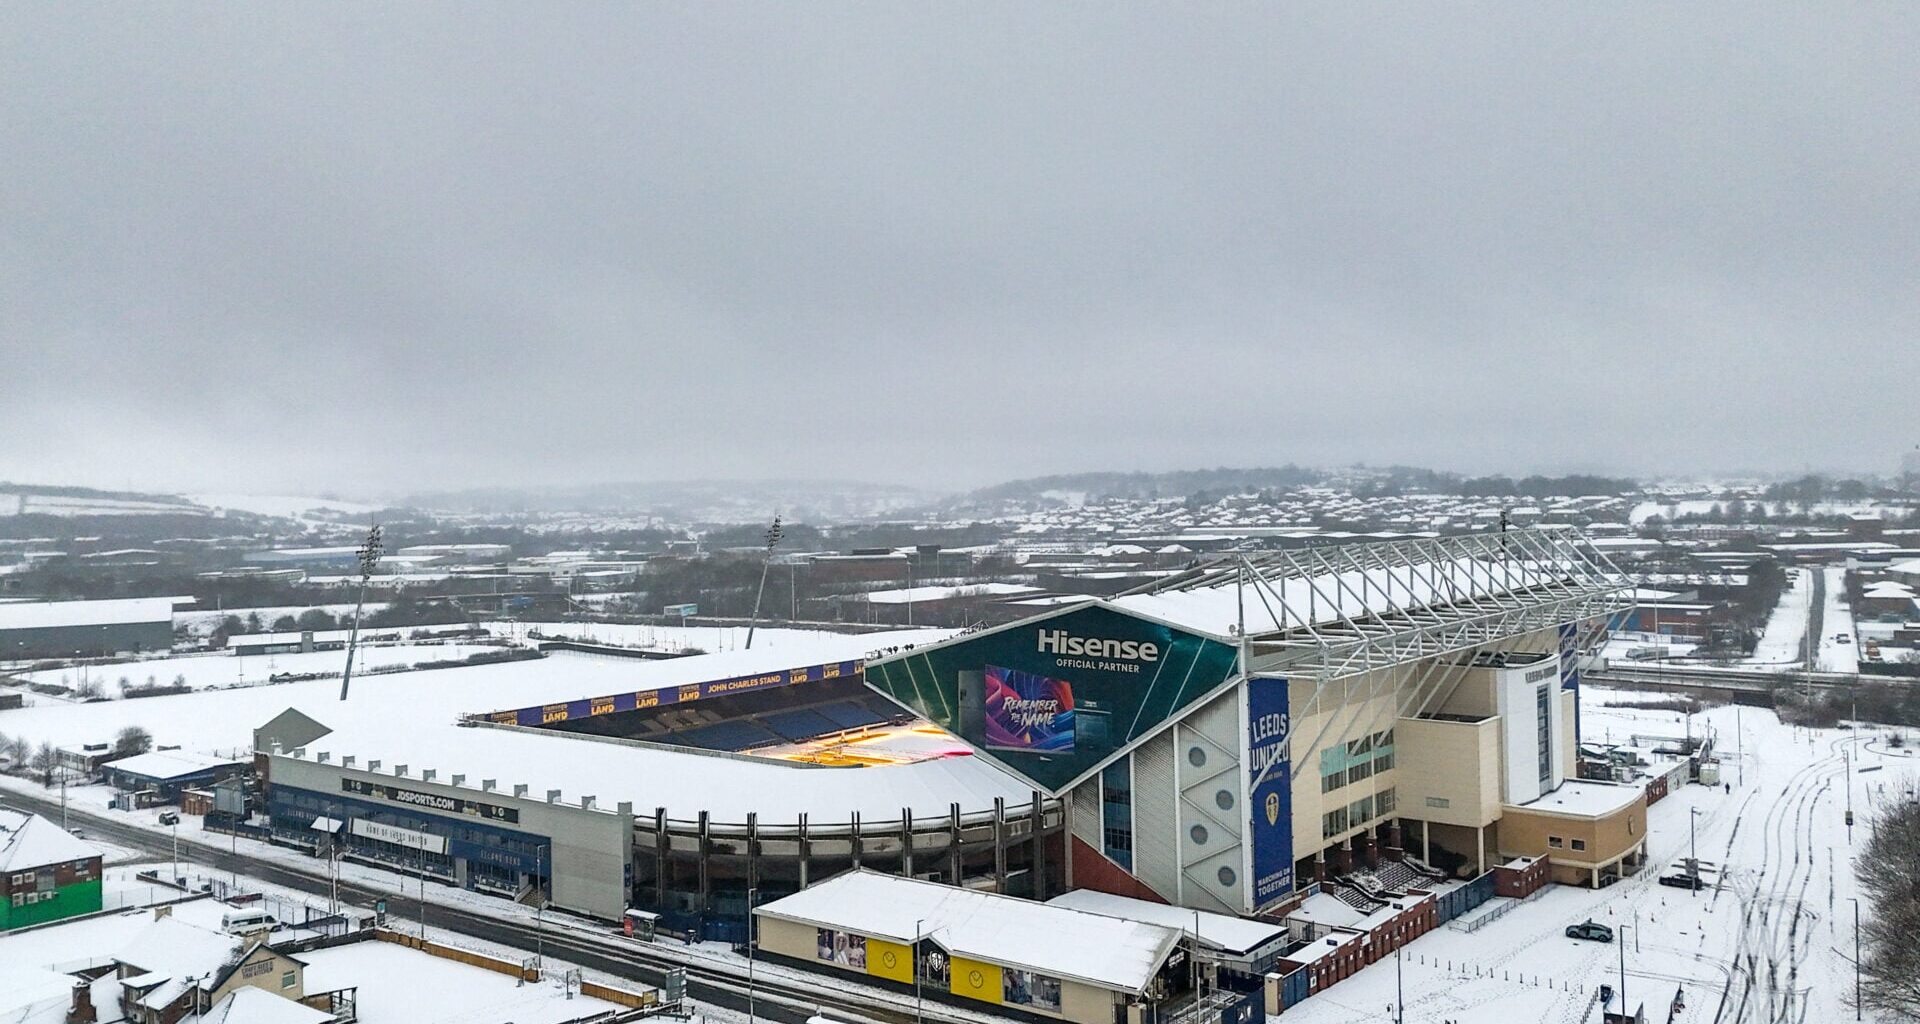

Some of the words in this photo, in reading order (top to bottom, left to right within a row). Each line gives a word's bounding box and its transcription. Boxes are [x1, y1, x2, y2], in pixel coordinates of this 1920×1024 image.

[1038, 628, 1158, 662] Hisense
[1056, 658, 1096, 670] OFFICIAL
[1098, 661, 1140, 674] PARTNER
[708, 684, 727, 693] JOHN
[728, 679, 758, 689] CHARLES
[760, 675, 781, 685] STAND
[636, 697, 659, 709] LAND
[679, 691, 700, 702] LAND
[1002, 696, 1058, 713] REMEMBER
[543, 710, 568, 724] LAND
[590, 703, 615, 716] LAND
[1020, 712, 1055, 727] NAME
[1253, 713, 1288, 743] LEEDS
[396, 790, 455, 810] JDSPORTS.COM
[1258, 875, 1290, 897] TOGETHER
